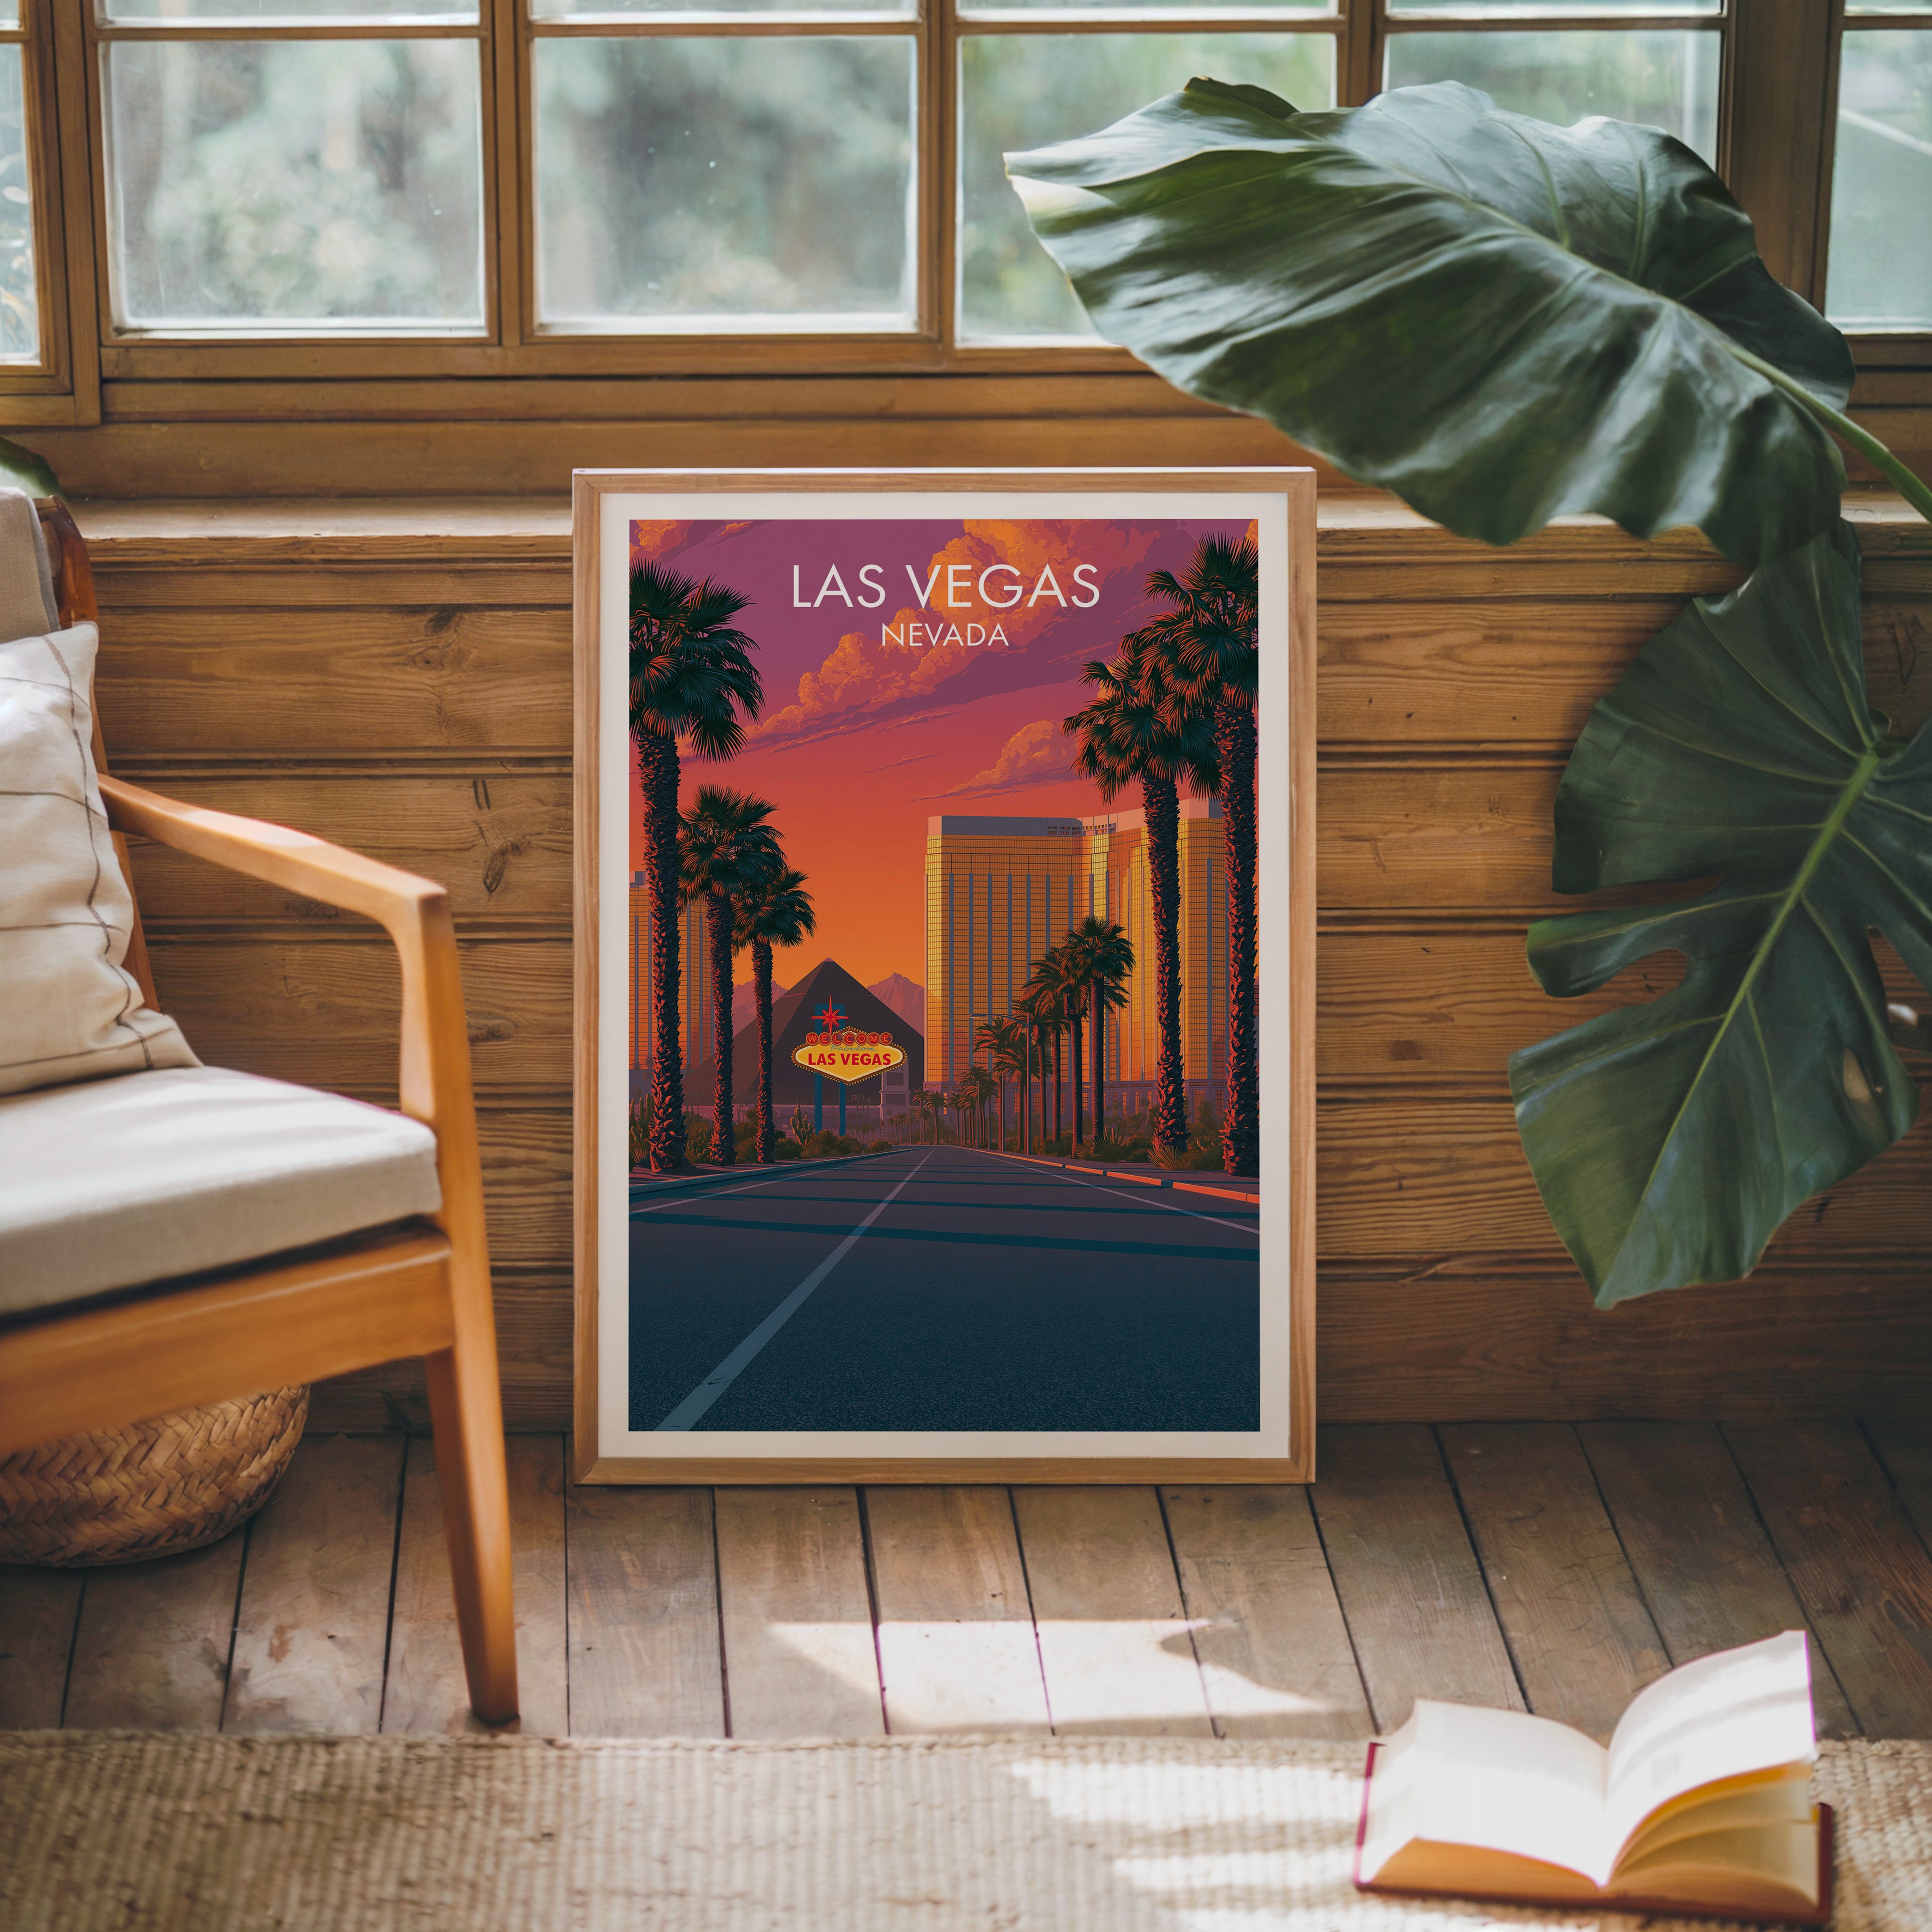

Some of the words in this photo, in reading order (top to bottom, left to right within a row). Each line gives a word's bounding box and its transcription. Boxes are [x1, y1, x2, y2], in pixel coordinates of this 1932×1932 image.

[793, 564, 886, 608] LAS
[905, 563, 1100, 609] VEGAS
[881, 622, 1009, 647] NEVADA
[807, 1034, 891, 1043] WELCOME
[808, 1053, 836, 1066] LAS
[840, 1053, 891, 1066] VEGAS
